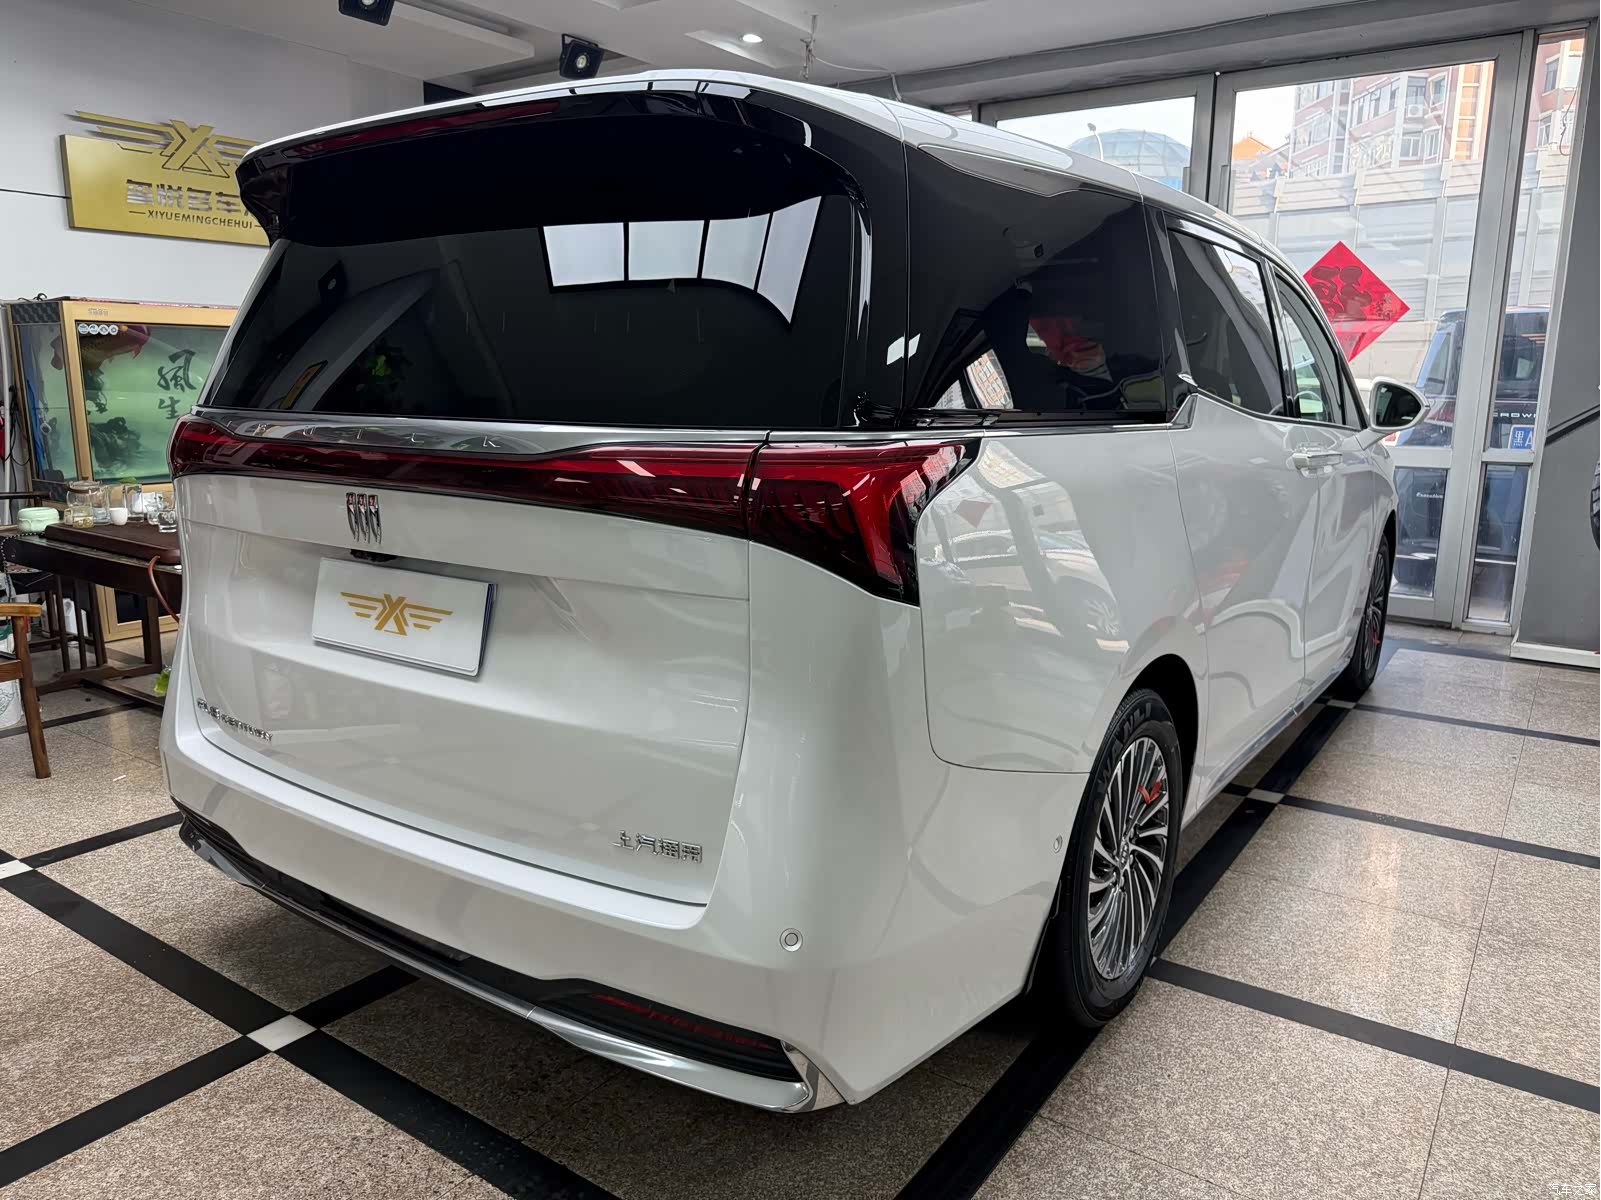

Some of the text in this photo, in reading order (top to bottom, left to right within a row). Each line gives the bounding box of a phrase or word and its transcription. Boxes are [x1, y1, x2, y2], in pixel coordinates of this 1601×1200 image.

[147, 209, 253, 229] XIYUEMINGCHEHUI
[612, 829, 703, 865] 上汽通用
